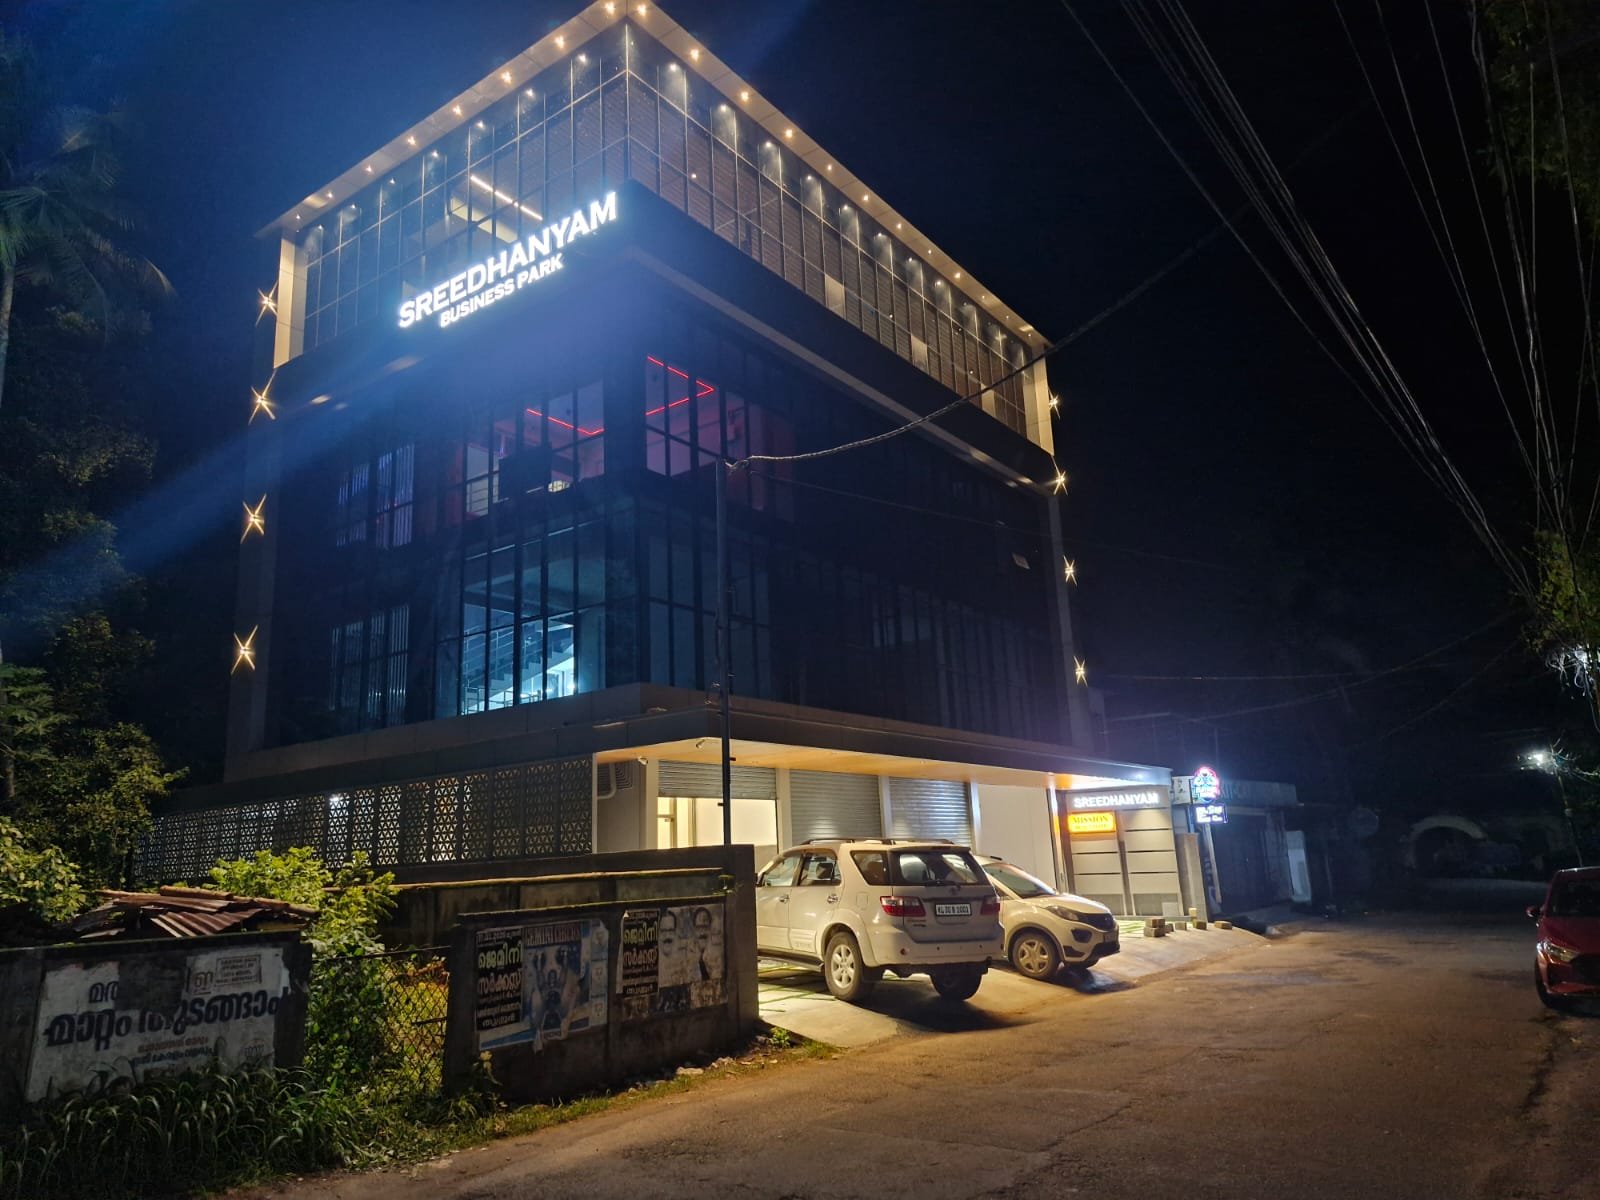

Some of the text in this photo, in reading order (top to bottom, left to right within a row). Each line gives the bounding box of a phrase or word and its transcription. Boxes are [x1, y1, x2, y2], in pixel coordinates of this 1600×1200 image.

[398, 190, 618, 328] SREEDHANYAM
[440, 252, 565, 328] BUSINESS PARK
[1074, 792, 1159, 808] SREEDHANYAM
[478, 940, 523, 968] ജെമിനി
